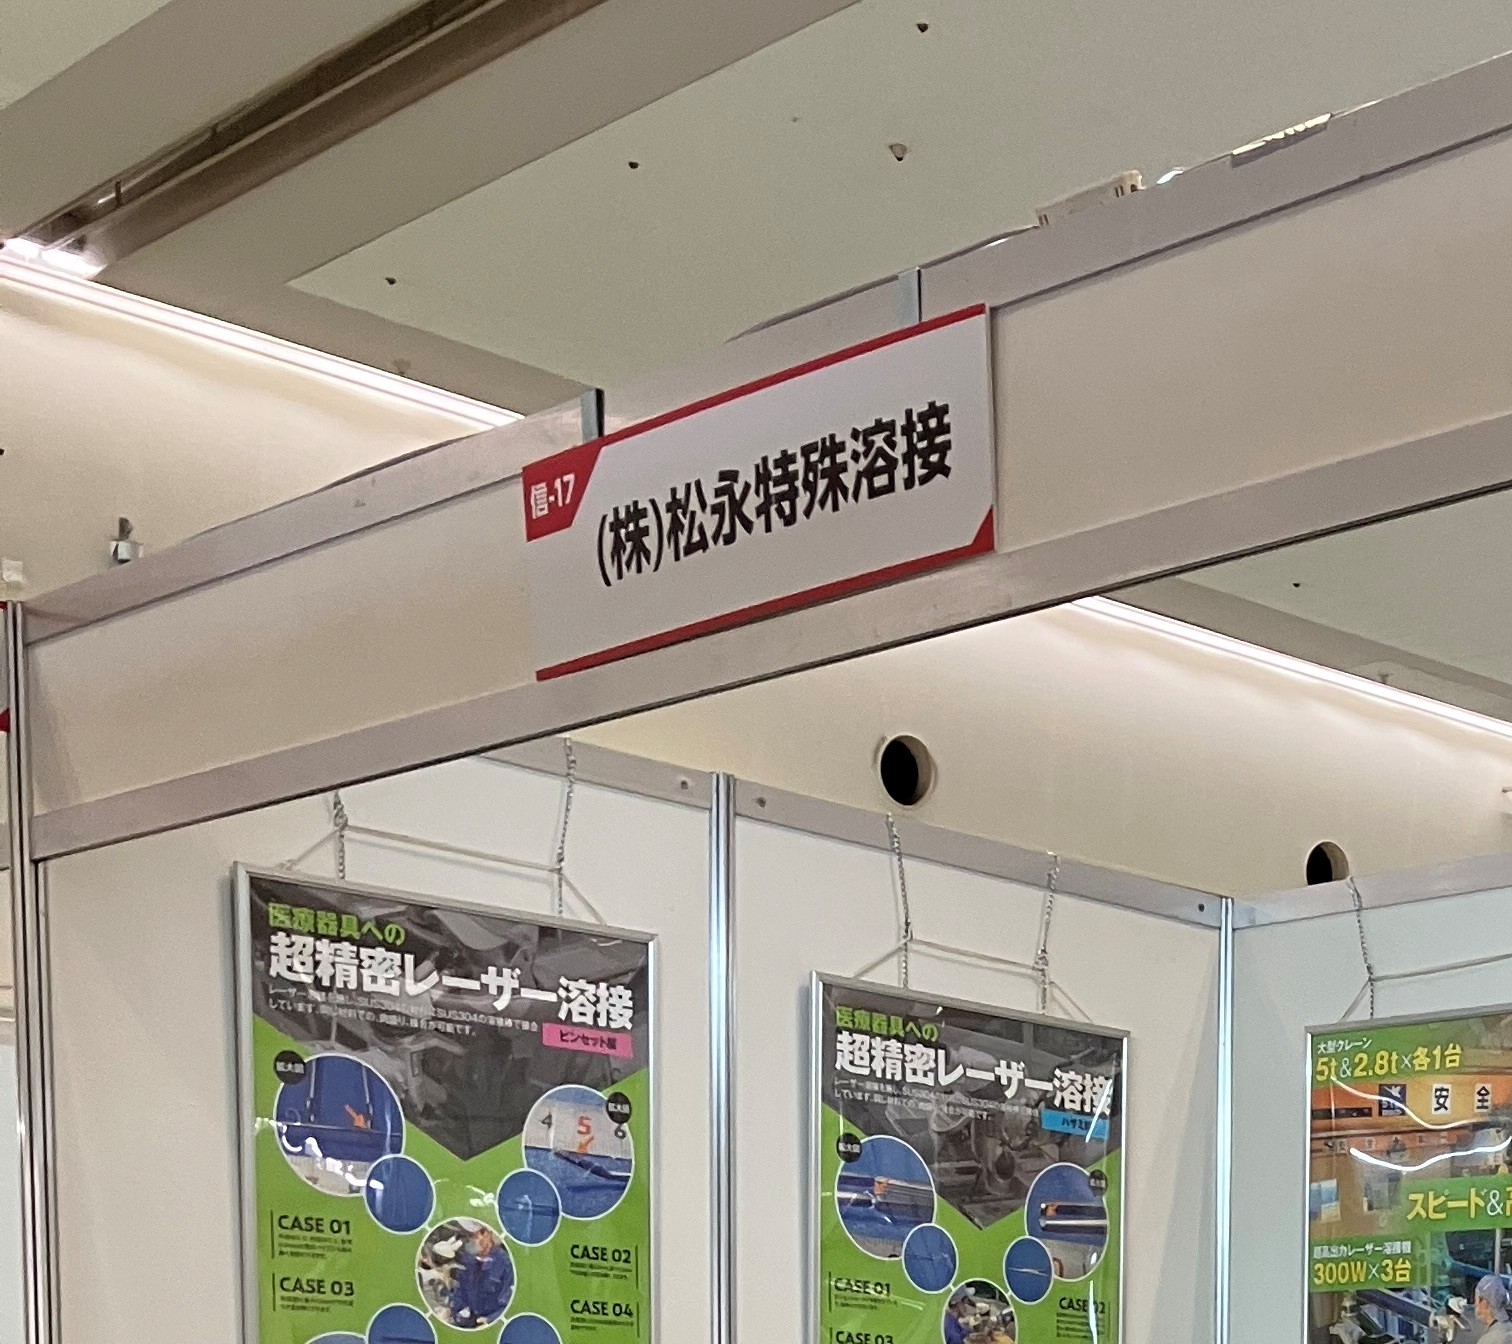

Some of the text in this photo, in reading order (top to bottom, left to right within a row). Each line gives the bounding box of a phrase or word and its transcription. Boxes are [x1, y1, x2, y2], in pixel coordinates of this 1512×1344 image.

[597, 401, 952, 586] (株)松永特殊溶接
[267, 902, 406, 945] 医療器具への
[269, 932, 634, 1030] 超精密レーザー溶接
[835, 1006, 939, 1042] 医療器具への
[835, 1030, 1113, 1114] 超精密レーザー溶接
[278, 1214, 351, 1235] CASE 01
[570, 1244, 632, 1264] CASE 02
[1313, 1258, 1412, 1285] 300W×3台
[279, 1277, 355, 1297] CASE 03
[834, 1277, 871, 1294] CASE
[570, 1299, 633, 1318] CASE 04
[1059, 1297, 1088, 1312] CASE
